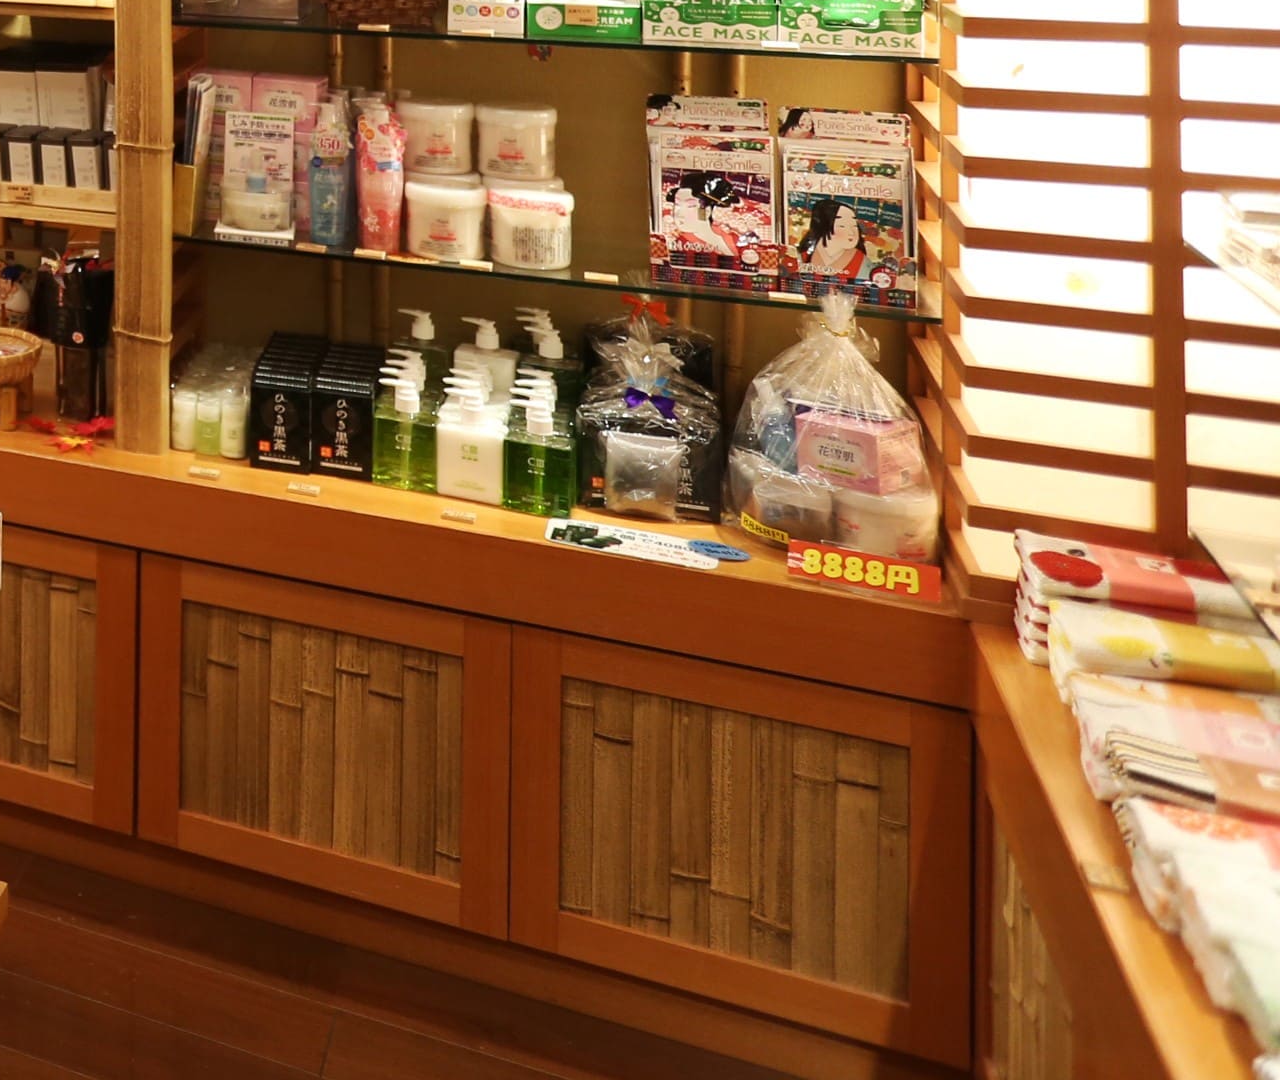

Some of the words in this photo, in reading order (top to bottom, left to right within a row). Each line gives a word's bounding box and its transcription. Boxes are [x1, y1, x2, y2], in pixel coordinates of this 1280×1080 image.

[651, 25, 704, 39] FACE
[713, 28, 772, 43] MASK
[789, 32, 845, 46] FACE
[855, 35, 918, 49] MASK
[692, 155, 724, 170] Pure
[725, 158, 762, 172] Smile
[819, 178, 853, 195] Pure
[854, 181, 894, 198] Smile
[817, 443, 856, 465] 花雪肌
[801, 547, 921, 595] 8888円
